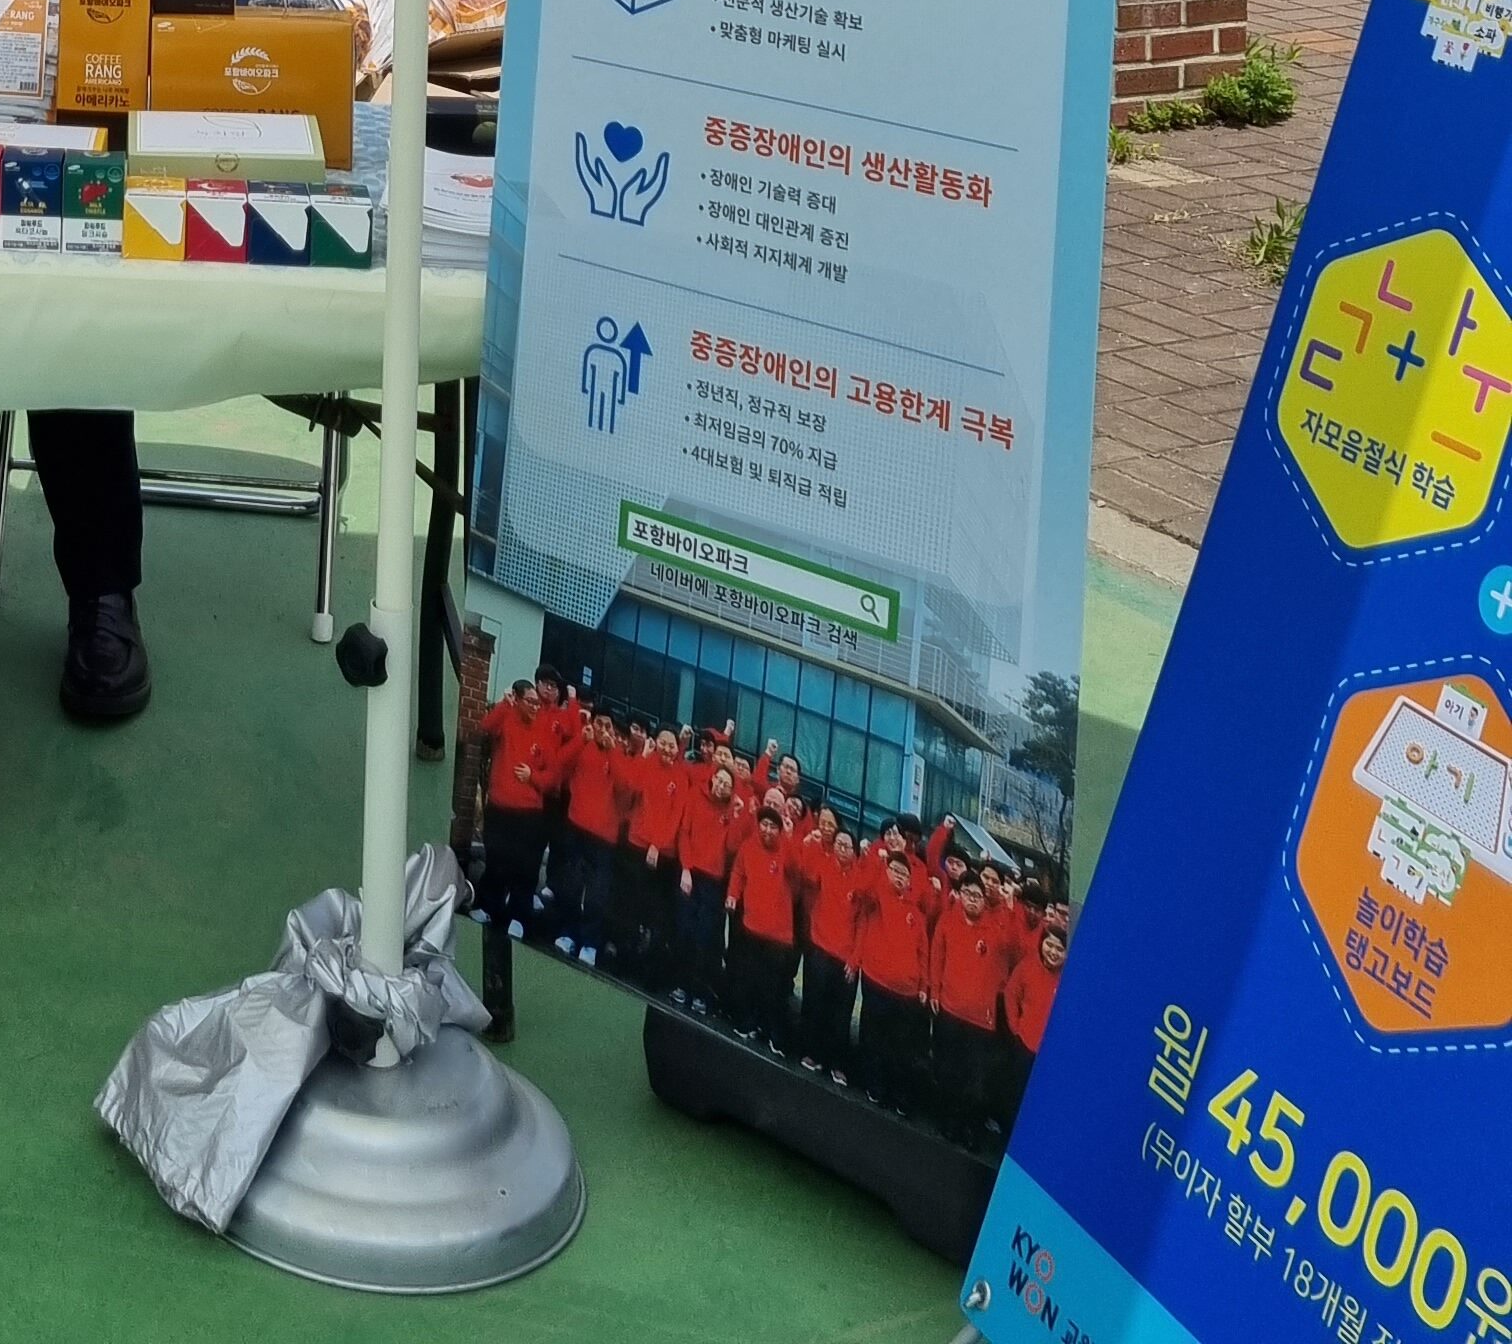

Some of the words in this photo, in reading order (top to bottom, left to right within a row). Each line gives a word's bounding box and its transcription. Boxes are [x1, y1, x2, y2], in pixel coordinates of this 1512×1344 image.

[719, 19, 763, 46] 맞춤형
[766, 29, 812, 55] 마케팅
[816, 37, 847, 62] 실시
[833, 7, 864, 32] 확보
[84, 78, 122, 86] AMERICANO
[85, 53, 122, 64] COFFEE
[85, 64, 122, 79] RANG
[75, 93, 131, 109] 아메리카노
[703, 116, 852, 177] 중증장애인의
[860, 150, 993, 210] 생산활동화
[709, 167, 753, 193] 장애인
[757, 177, 802, 207] 기술력
[806, 189, 838, 215] 증대
[707, 199, 751, 227] 장애인
[754, 209, 815, 244] 대인관계
[819, 225, 850, 251] 증진
[704, 231, 749, 260] 사회적
[753, 243, 813, 276] 지지체계
[816, 258, 849, 284] 개발
[689, 329, 838, 400] 중증장애인의
[846, 372, 951, 433] 고용한계
[960, 405, 1016, 451] 극복
[694, 379, 744, 411] 정년직,
[747, 392, 792, 423] 정규직
[796, 407, 828, 434] 보장
[693, 410, 768, 451] 최저임금의
[769, 433, 804, 461] 70%
[806, 443, 839, 472] 지급
[1300, 407, 1408, 487] 자모음절식
[1411, 460, 1457, 511] 학습
[690, 444, 745, 477] 4대보험
[748, 460, 764, 482] 및
[817, 480, 849, 510] 적립
[631, 518, 750, 576] 포항바이오파크
[649, 560, 709, 597] 네이버에
[712, 580, 822, 637] 포항바이오파크
[826, 622, 859, 653] 검색
[1444, 697, 1465, 721] 아기
[1356, 885, 1450, 978] 놀이학습
[1344, 927, 1437, 1020] 탱고보드
[1148, 1003, 1209, 1115] 월
[1141, 1121, 1222, 1219] (무이자
[1223, 1192, 1277, 1262] 할부
[1011, 1224, 1056, 1284] KYO
[1008, 1260, 1060, 1332] WON
